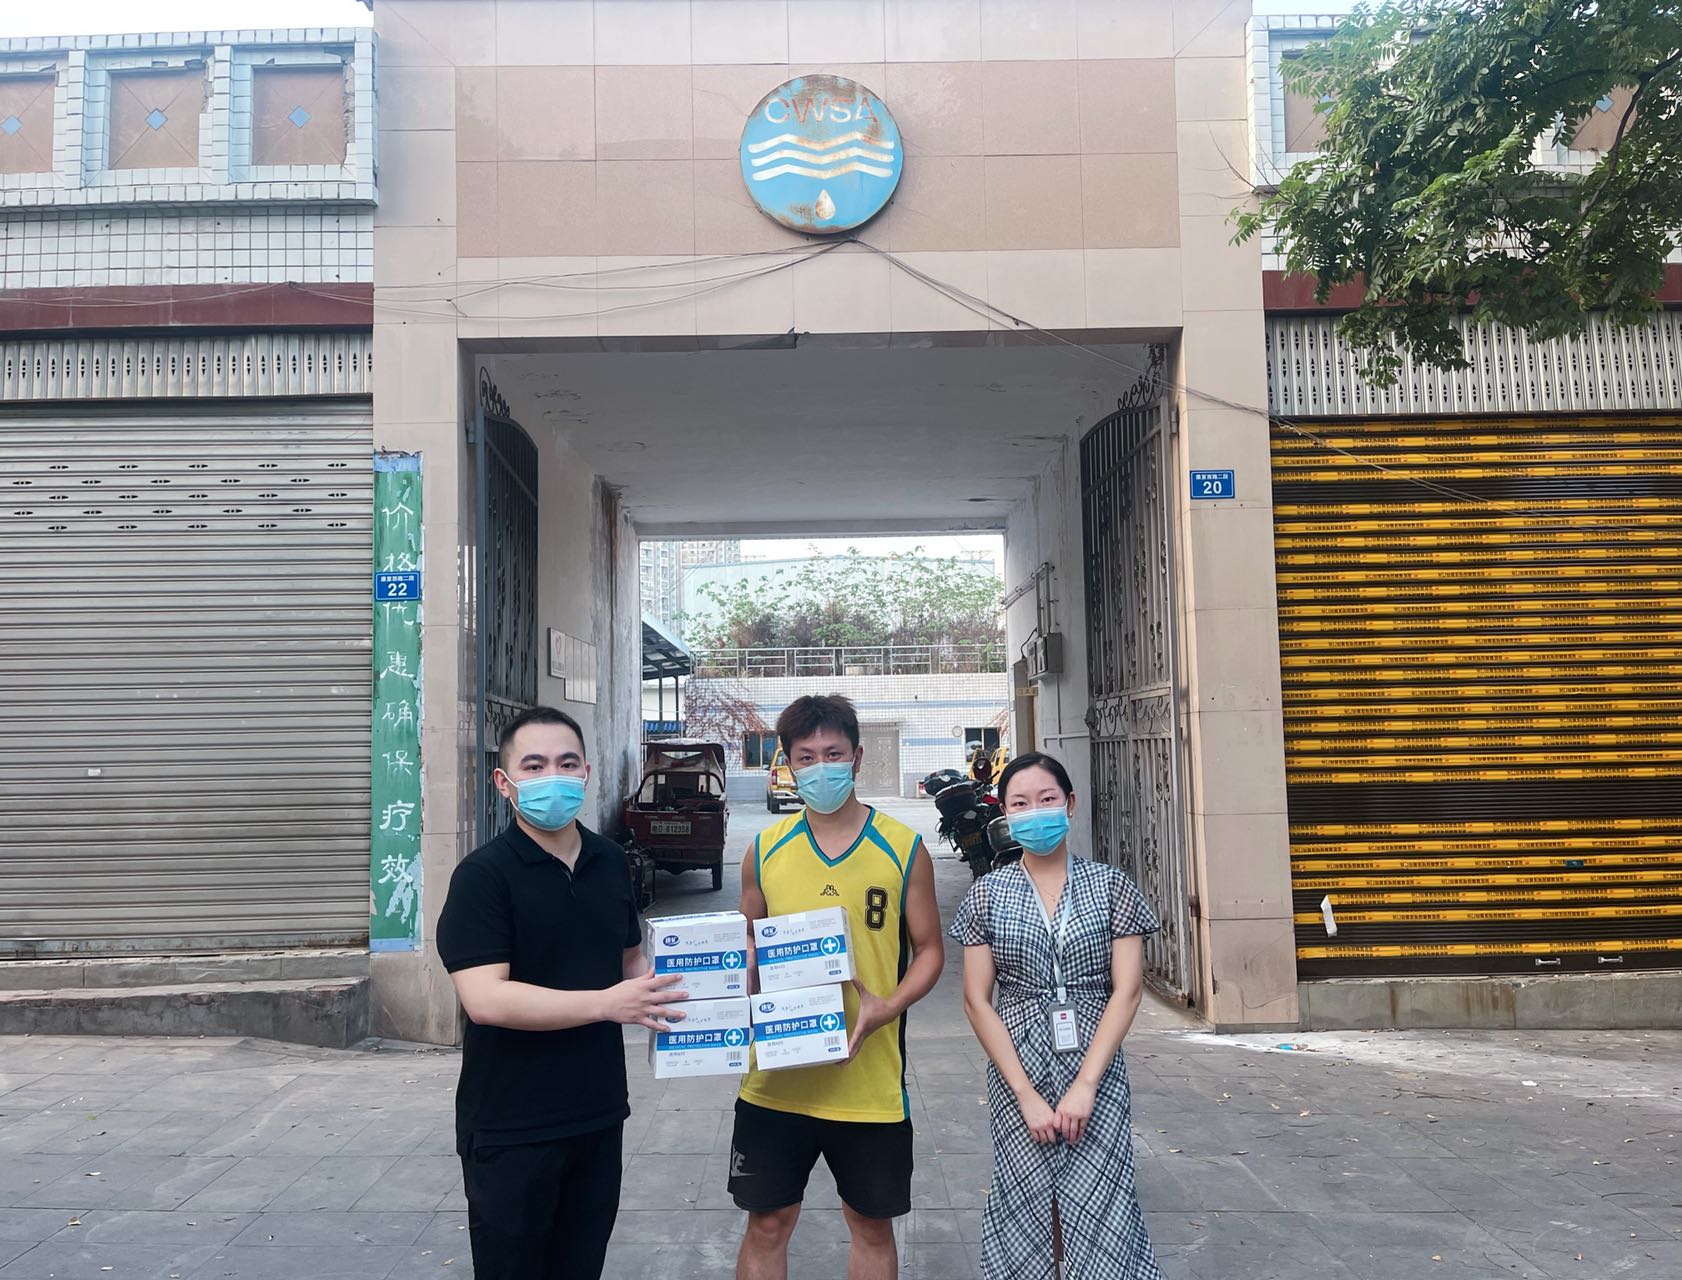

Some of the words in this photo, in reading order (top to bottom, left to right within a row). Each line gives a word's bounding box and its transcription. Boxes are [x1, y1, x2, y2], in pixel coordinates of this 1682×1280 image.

[764, 96, 878, 124] CWSA
[1203, 481, 1222, 494] 20
[387, 582, 408, 597] 22
[865, 886, 888, 932] 8
[767, 942, 818, 959] 医用防护口罩
[666, 956, 720, 968] 医用防护口罩
[765, 1019, 817, 1035] 医用防护口罩
[668, 1033, 722, 1045] 医用防护口罩
